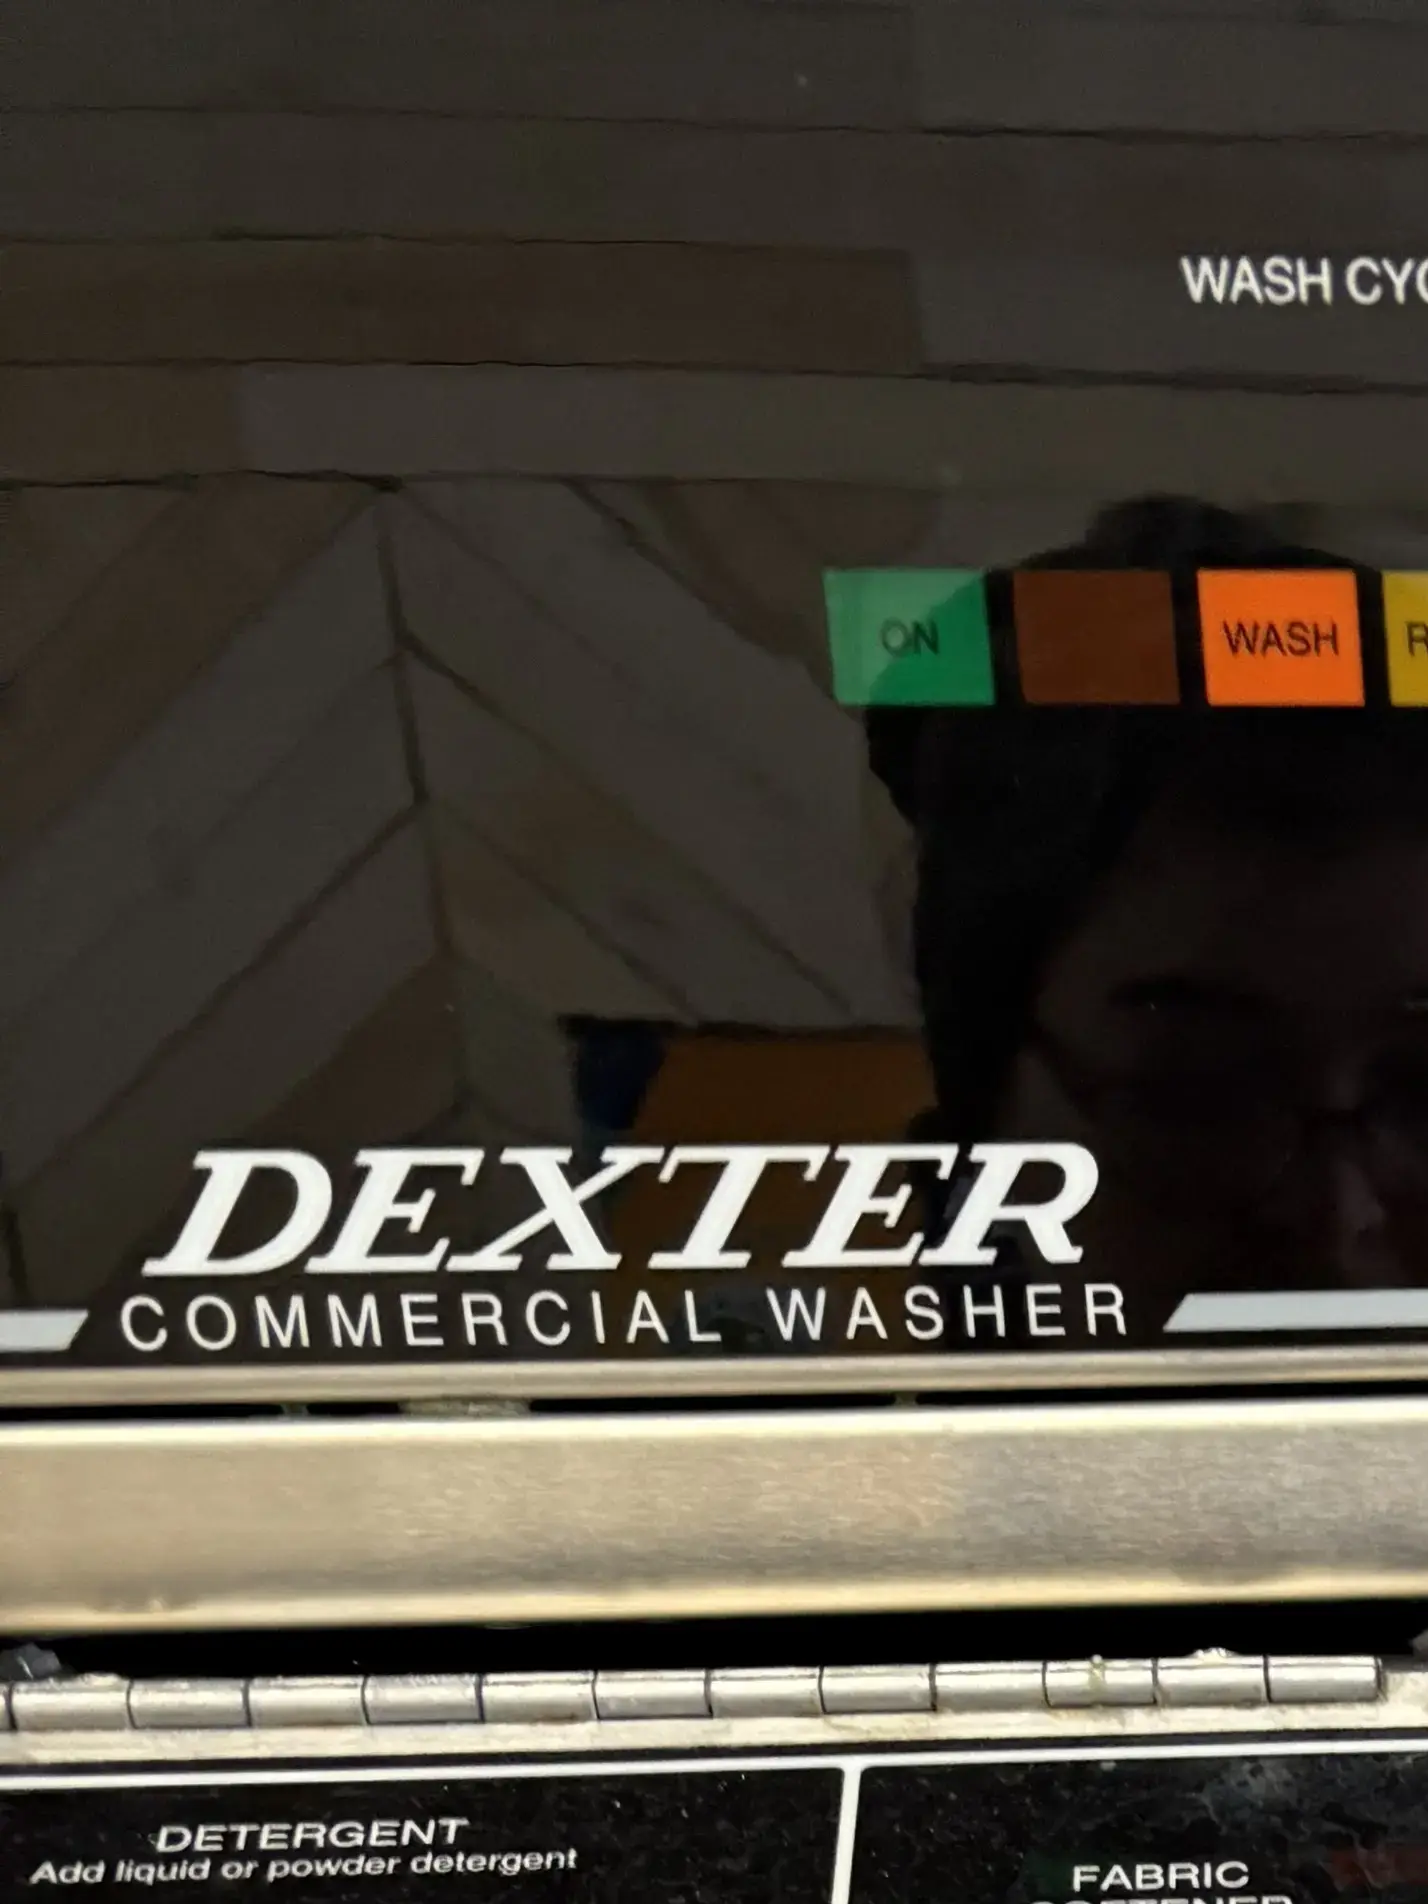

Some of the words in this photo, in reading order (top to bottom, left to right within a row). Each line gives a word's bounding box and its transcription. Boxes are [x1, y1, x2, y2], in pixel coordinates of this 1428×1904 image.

[1180, 256, 1332, 305] WASH
[881, 618, 940, 656] ON
[1223, 620, 1339, 657] WASH
[142, 1141, 1101, 1278] DEXTER
[119, 1289, 722, 1353] COMMERCIAL
[766, 1281, 1128, 1339] WASHER
[155, 1818, 469, 1852] DETERGENT
[30, 1860, 105, 1885] Add
[114, 1857, 211, 1886] liquid
[222, 1858, 259, 1879] or
[267, 1852, 401, 1881] powder
[411, 1848, 578, 1876] detergent
[1072, 1861, 1249, 1890] FABRIC
